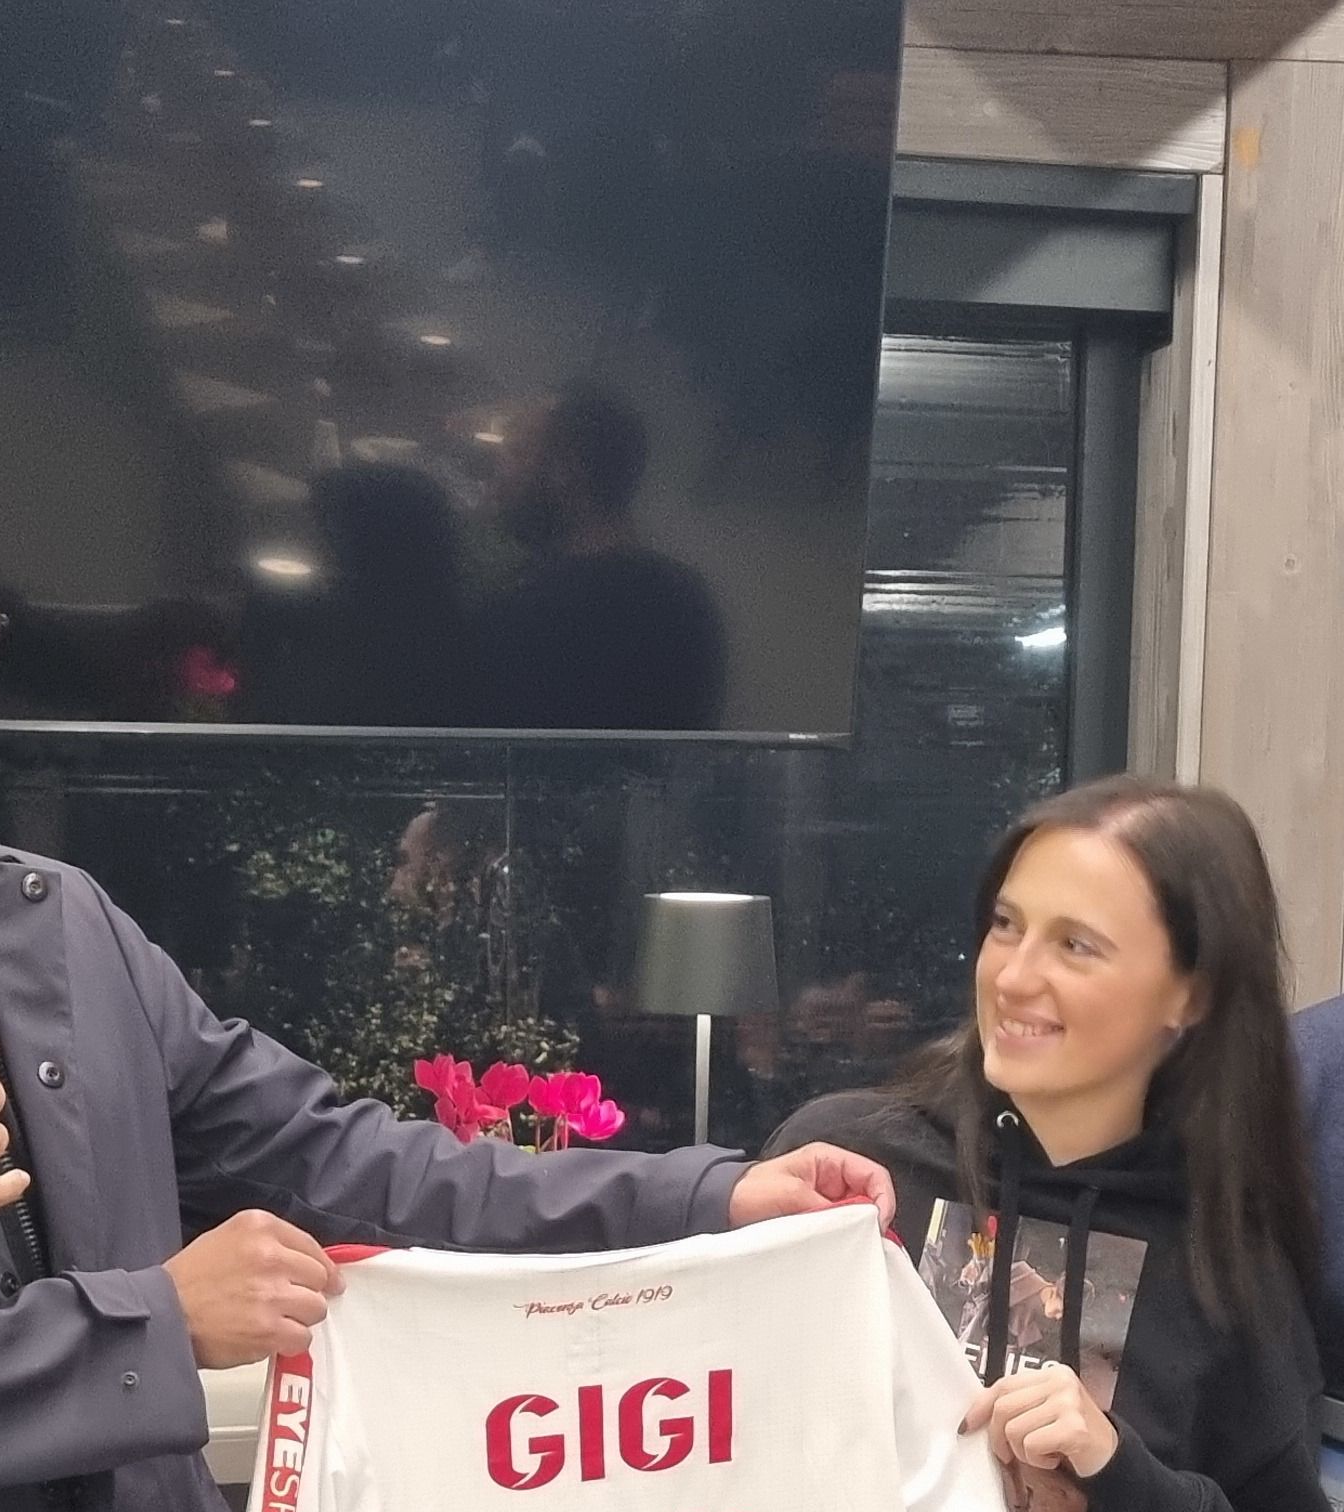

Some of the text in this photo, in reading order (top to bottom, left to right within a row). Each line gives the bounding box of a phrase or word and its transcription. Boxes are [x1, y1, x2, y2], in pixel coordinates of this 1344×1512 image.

[590, 1292, 632, 1310] Calcio
[636, 1285, 673, 1304] 1919
[484, 1367, 734, 1491] GIGI
